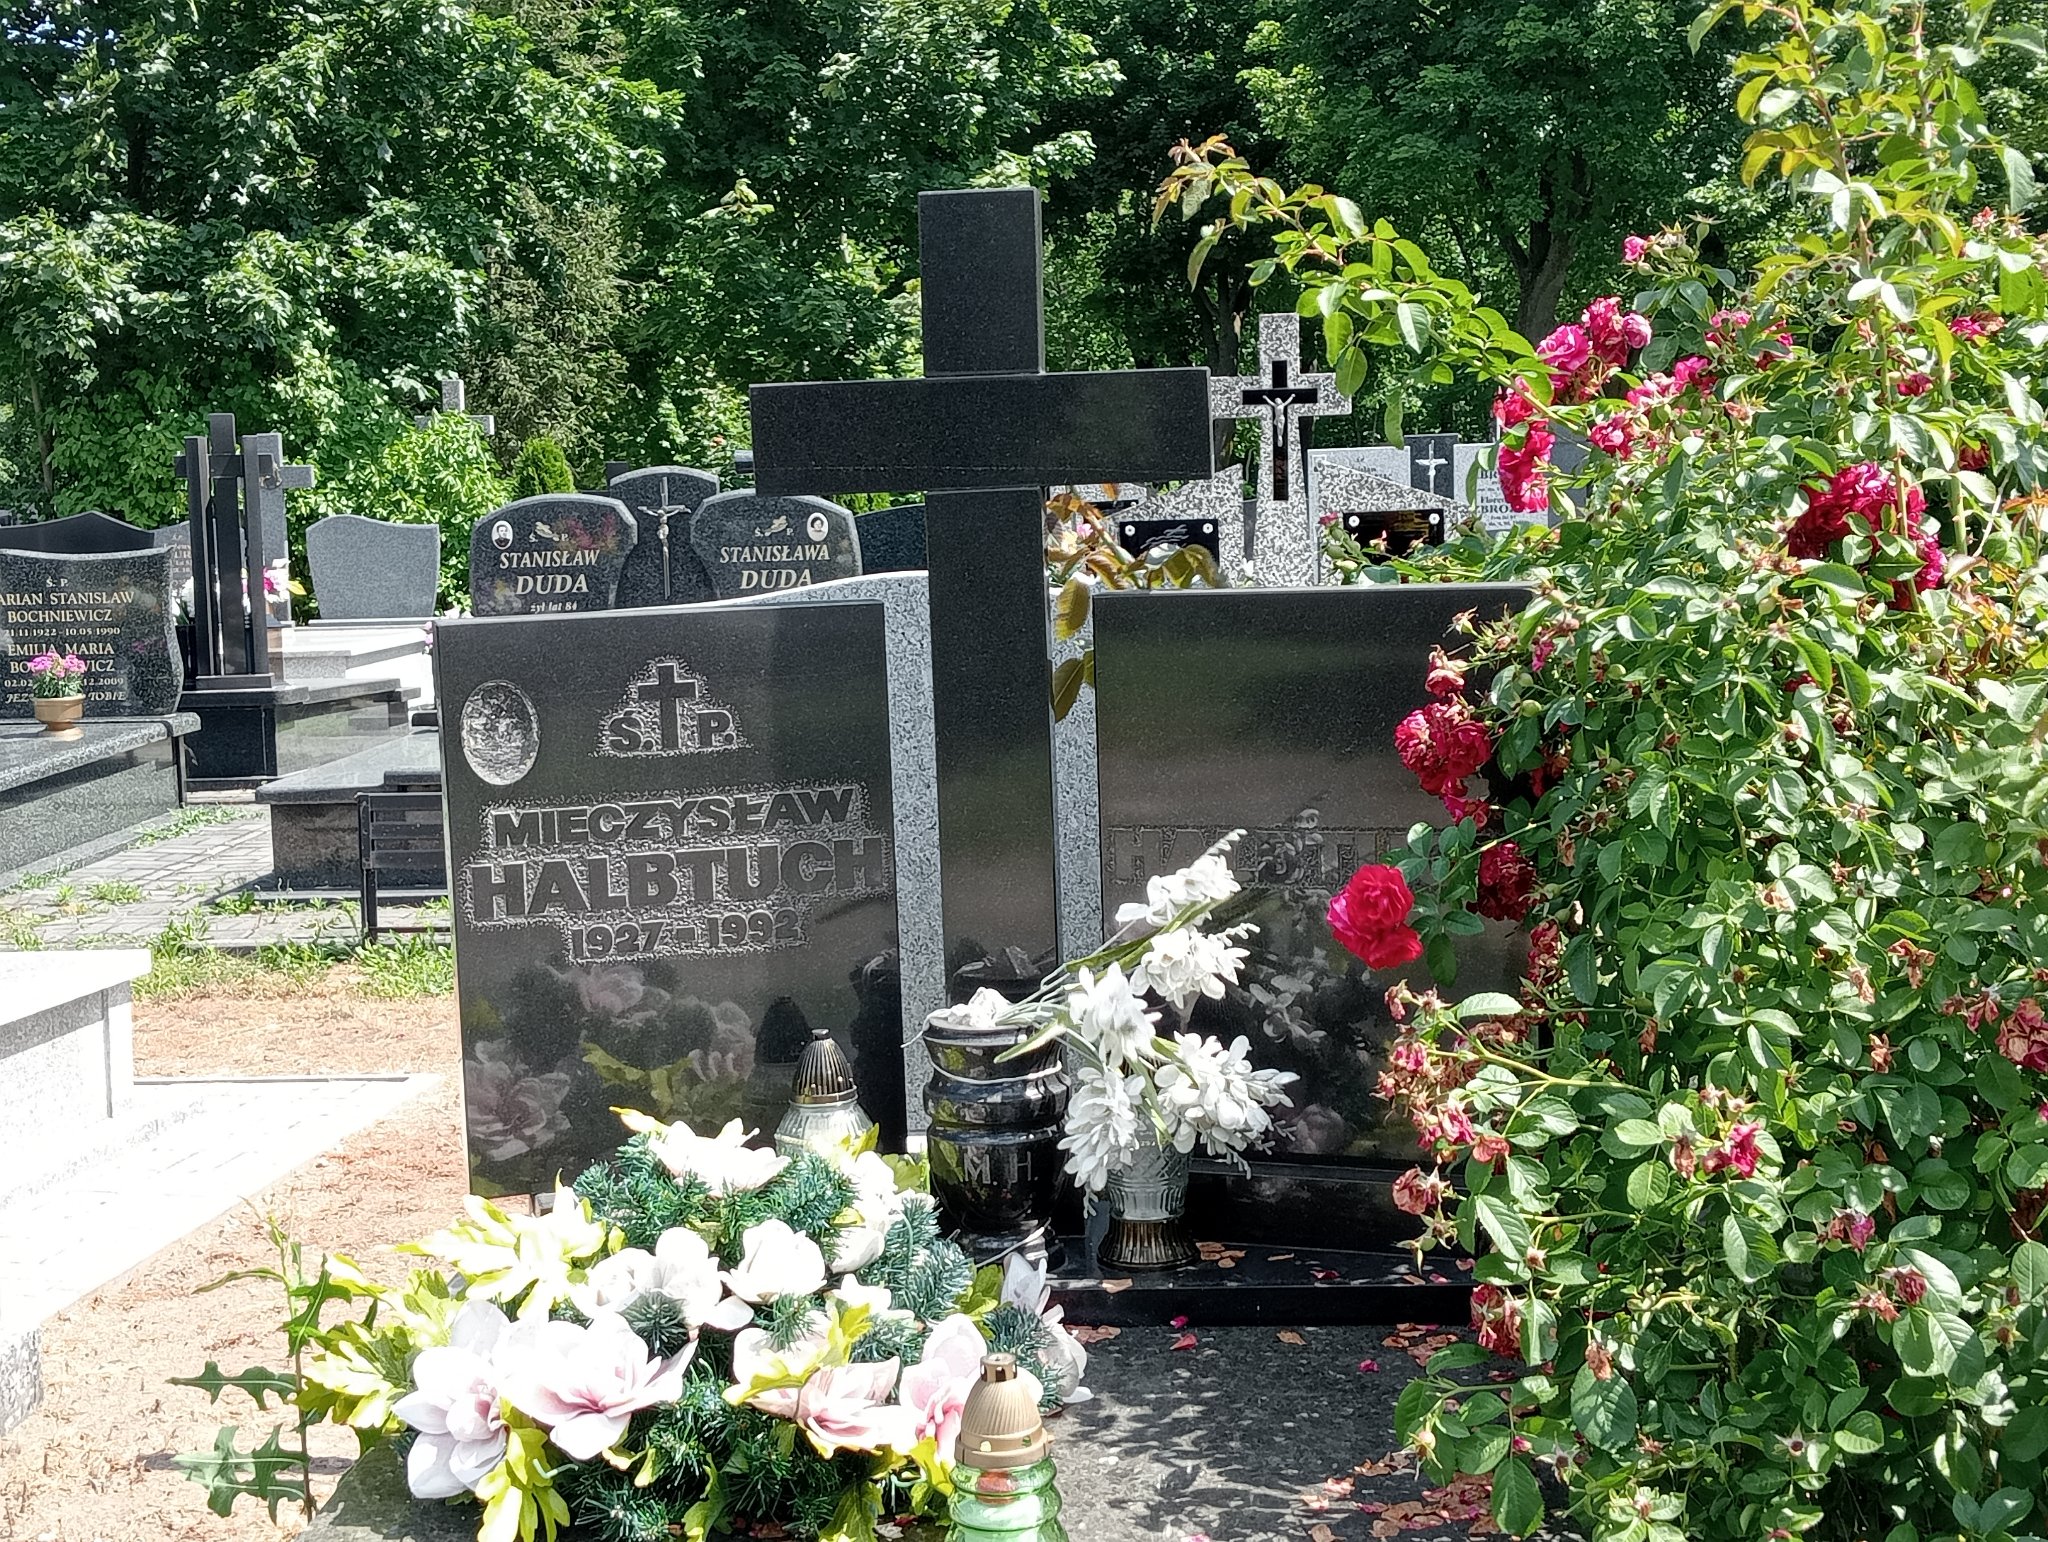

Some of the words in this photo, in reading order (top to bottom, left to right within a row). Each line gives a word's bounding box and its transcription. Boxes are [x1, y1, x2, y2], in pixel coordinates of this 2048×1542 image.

[499, 549, 600, 569] STANISŁAW
[719, 544, 831, 564] STANISŁAWA
[516, 573, 589, 595] DUDA
[739, 568, 813, 590] DUDA
[0, 592, 43, 606] ARIAN
[7, 608, 113, 623] BOCHNIEWICZ
[8, 643, 57, 657] EMILIA
[64, 642, 115, 656] MARIA
[697, 709, 737, 748] P.
[493, 787, 858, 849] MIECZYSŁAW
[470, 836, 886, 919] HALBTUCH
